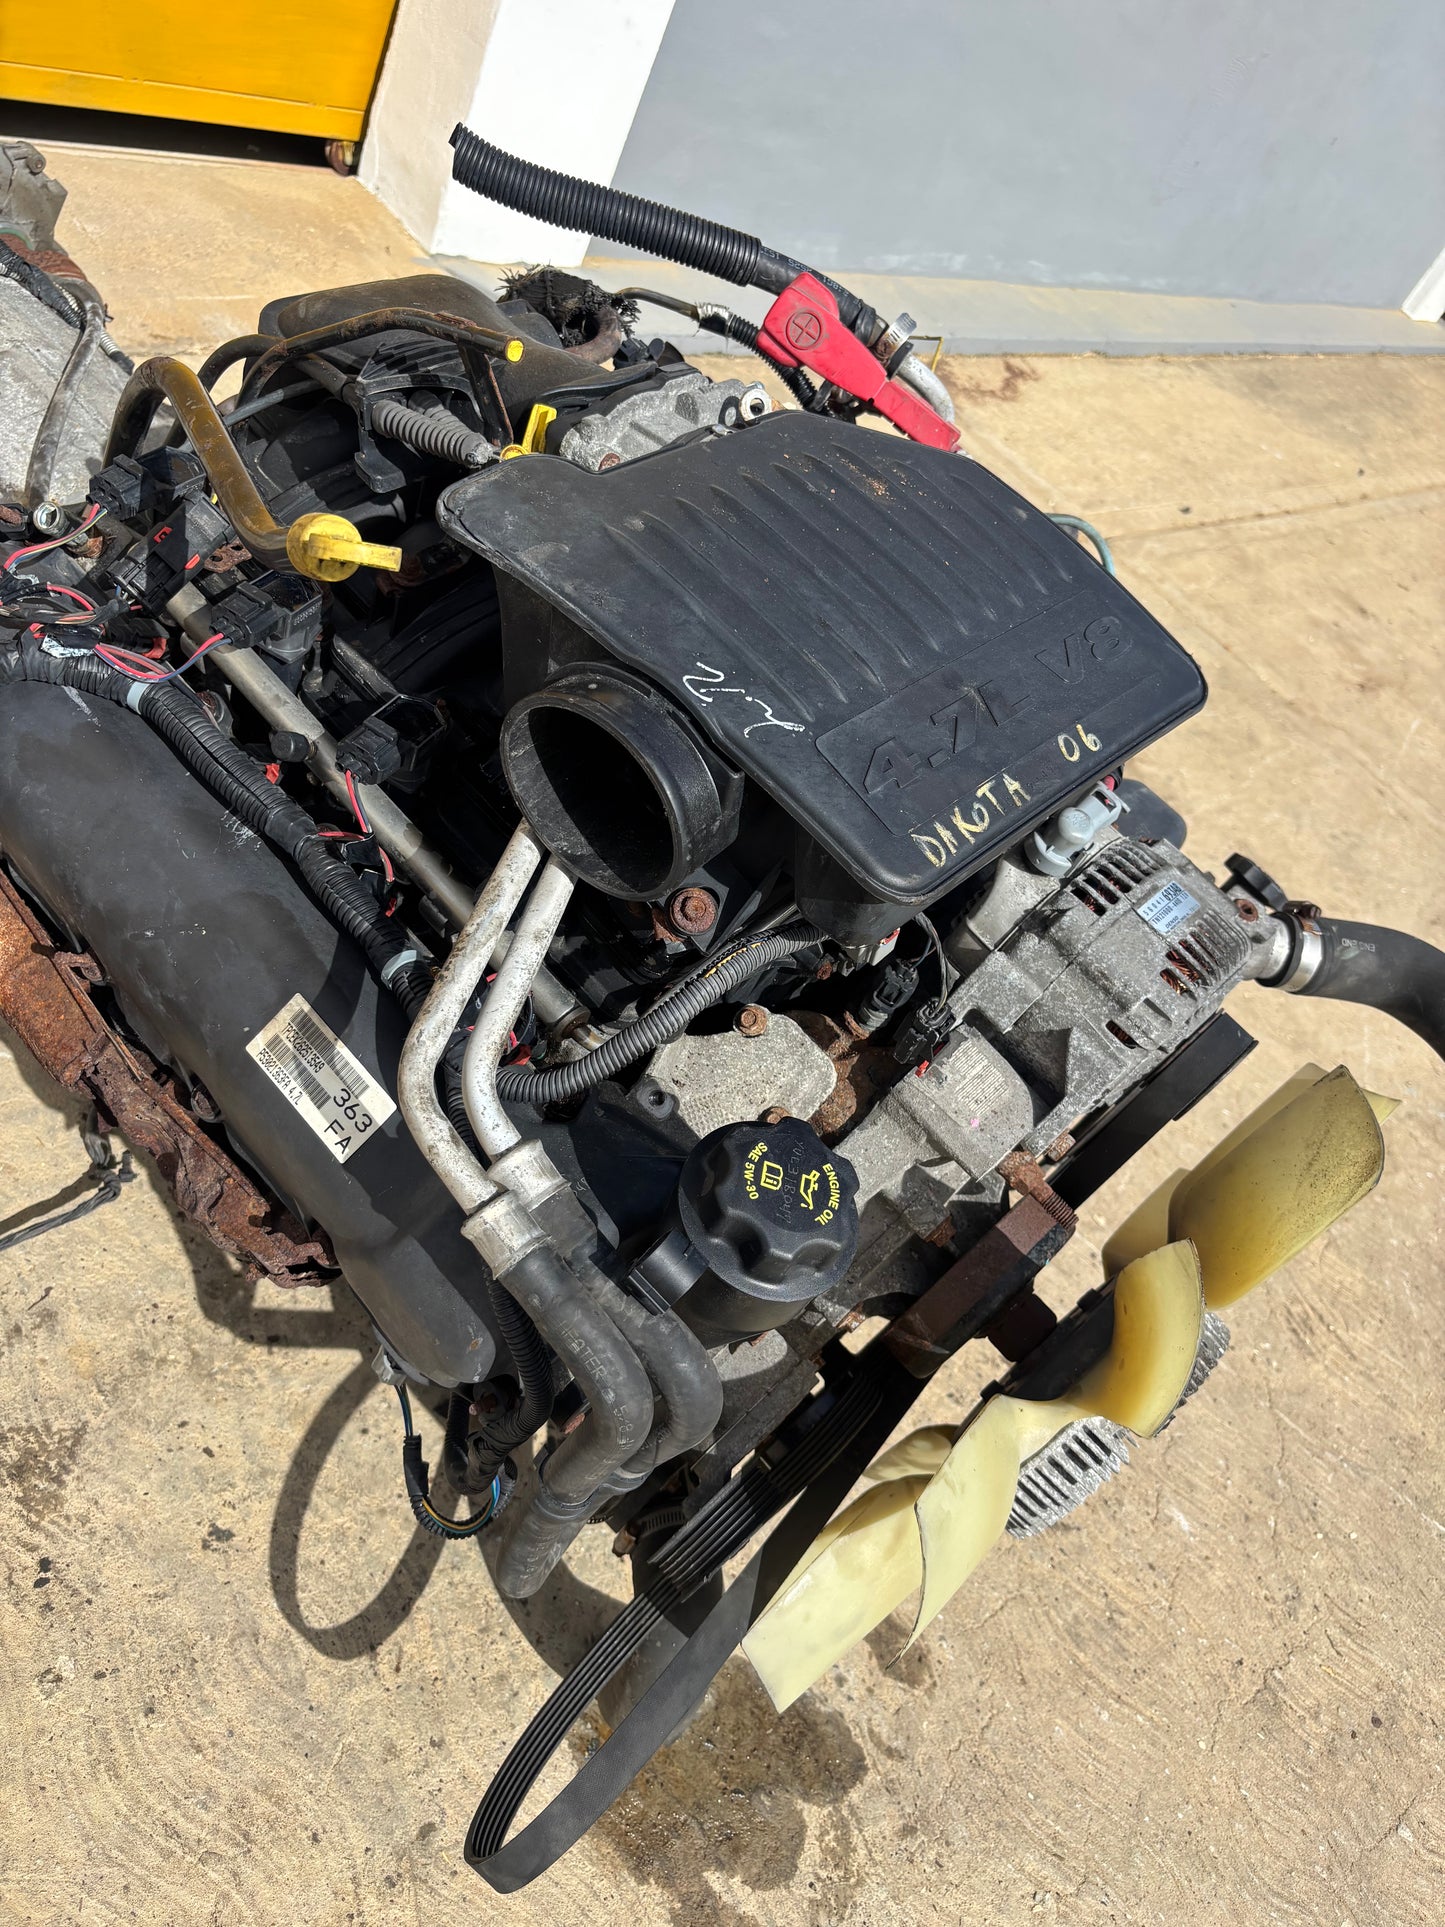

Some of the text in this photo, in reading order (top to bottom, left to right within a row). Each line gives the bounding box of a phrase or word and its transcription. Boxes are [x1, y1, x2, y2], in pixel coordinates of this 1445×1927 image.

[862, 679, 1037, 795] 4.7L
[1033, 615, 1133, 685] V8
[910, 723, 1104, 868] DAKOTA 06
[1165, 915, 1179, 929] DENSO
[286, 1085, 304, 1106] 4.7L
[333, 1088, 373, 1133] 363
[323, 1118, 353, 1155] FA
[743, 1141, 769, 1200] SAE 5W-30
[814, 1162, 841, 1226] ENGINE OIL
